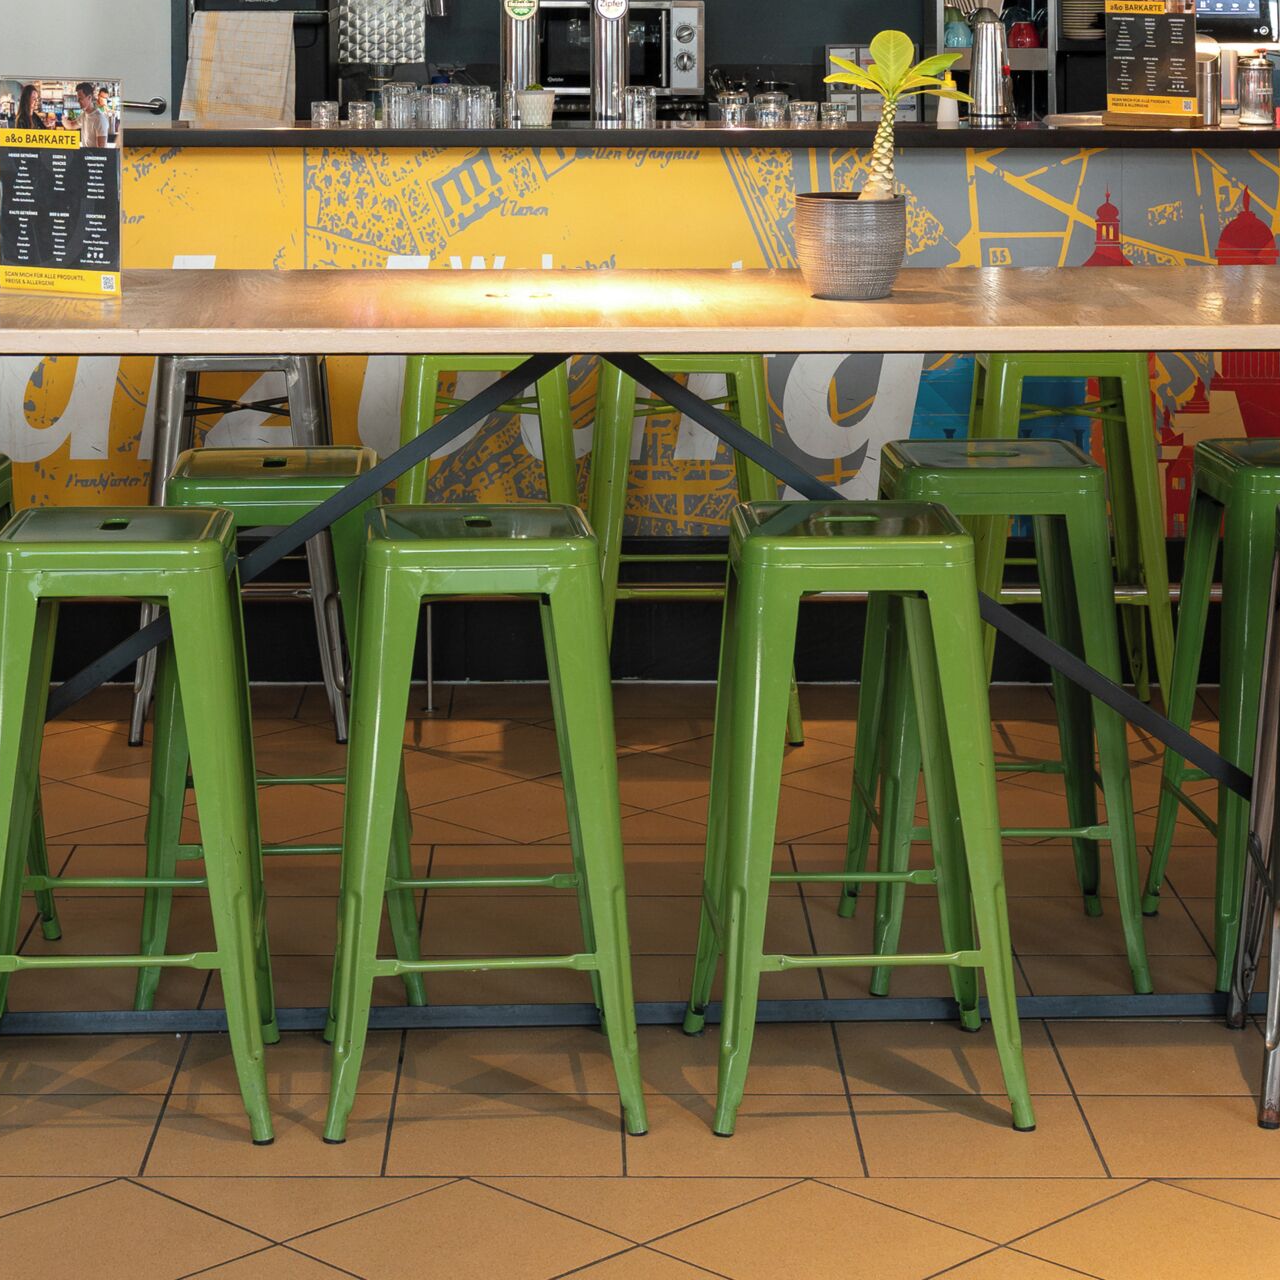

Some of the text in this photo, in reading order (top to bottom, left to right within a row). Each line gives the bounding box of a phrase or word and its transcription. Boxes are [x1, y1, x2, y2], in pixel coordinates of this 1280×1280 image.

[600, 0, 623, 8] Zipfer
[1125, 4, 1163, 12] BARKARTE
[5, 134, 76, 145] a&o BARKARTE
